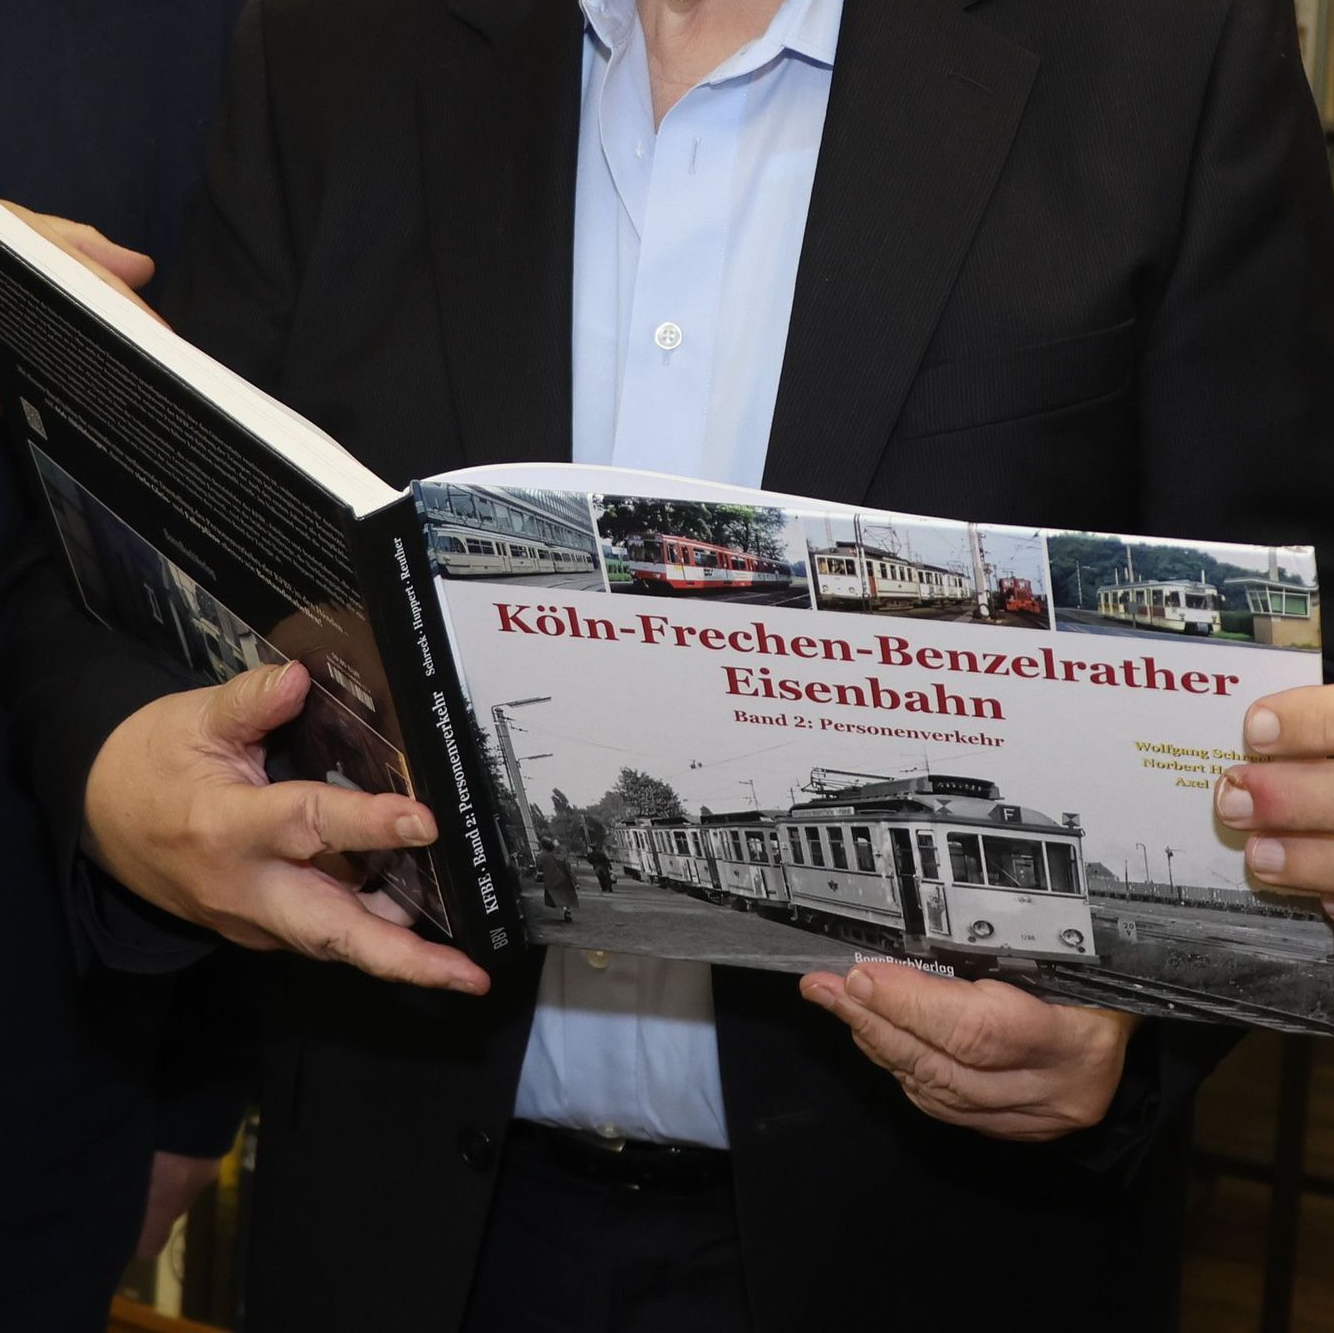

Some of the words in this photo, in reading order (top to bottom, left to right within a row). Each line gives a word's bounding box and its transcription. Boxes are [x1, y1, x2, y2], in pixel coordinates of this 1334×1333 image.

[394, 537, 411, 581] Reuther
[405, 586, 425, 631] Huppert
[417, 635, 436, 677] Schreck
[492, 602, 1240, 697] Köln-Frechen-Benzelrather
[720, 665, 1007, 721] Eisenbahn
[732, 709, 788, 728] Band
[793, 715, 814, 730] 2:
[819, 717, 1005, 747] Personenverkehr
[432, 690, 474, 814] Personenverkehr
[1134, 741, 1210, 760] Wolfgang
[1141, 758, 1206, 774] Norbert
[1175, 777, 1210, 790] Axel
[465, 828, 488, 867] Band
[477, 872, 500, 915] KFBE
[490, 925, 509, 951] BBV
